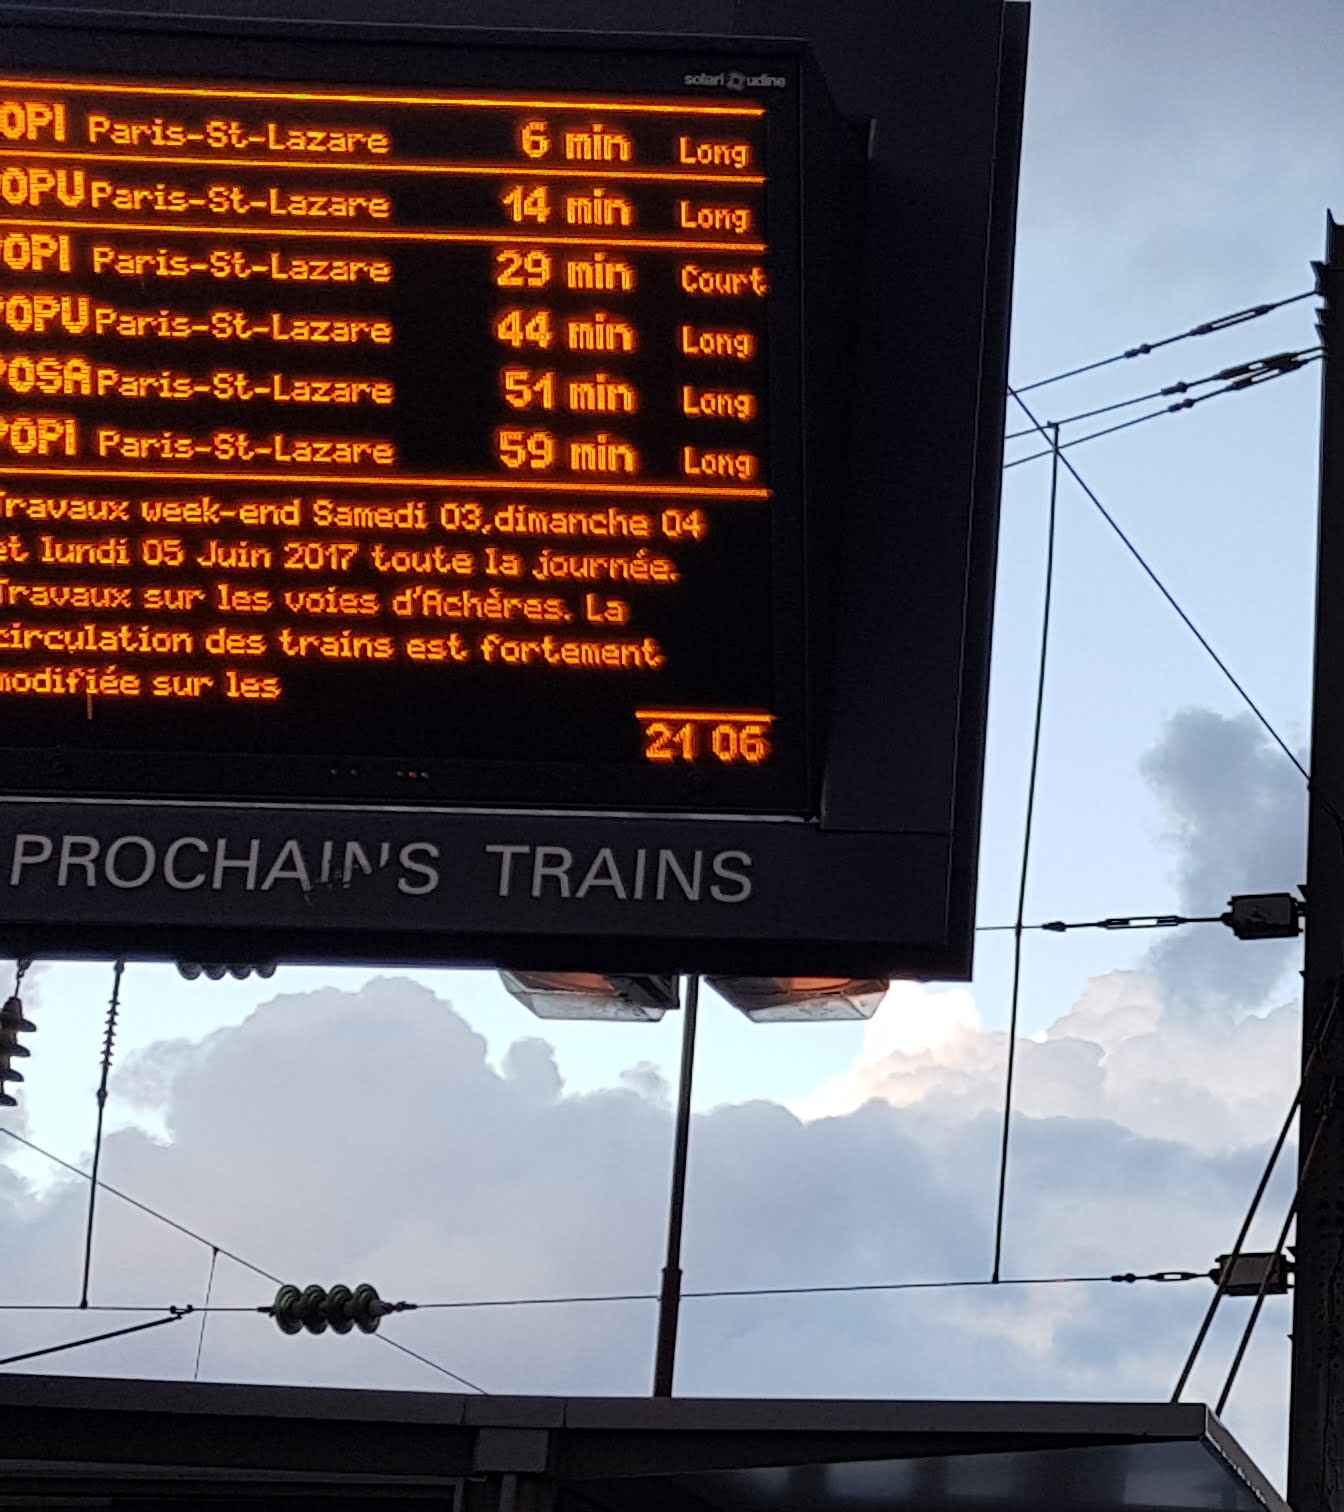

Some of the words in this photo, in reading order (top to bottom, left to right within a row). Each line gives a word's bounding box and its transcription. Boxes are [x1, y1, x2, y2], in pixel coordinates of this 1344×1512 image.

[88, 115, 390, 153] Paris-St-Lazare
[521, 121, 550, 158] 6
[565, 123, 631, 162] min
[679, 137, 748, 169] Long
[90, 181, 390, 218] Paris-St-Lazare
[502, 185, 552, 223] 14
[566, 187, 632, 226] min
[680, 201, 749, 233] Long
[0, 231, 71, 272] OPI
[93, 247, 391, 282] Paris-St-Lazare
[496, 249, 552, 287] 29
[567, 251, 633, 290] min
[681, 265, 767, 295] Court
[0, 293, 90, 334] OPU
[95, 307, 392, 343] Paris-St-Lazare
[497, 309, 553, 348] 44
[567, 313, 634, 351] min
[682, 326, 751, 359] Long
[0, 355, 92, 395] OSA
[97, 369, 393, 404] Paris-St-Lazare
[505, 369, 554, 409] 51
[569, 373, 635, 412] min
[683, 386, 752, 419] Long
[0, 416, 77, 456] OPI
[98, 429, 394, 464] Paris-St-Lazare
[499, 431, 555, 469] 59
[570, 433, 636, 472] min
[684, 447, 753, 480] Long
[141, 496, 301, 526] week-end
[312, 499, 428, 529] Samedi
[661, 509, 703, 538] 04
[41, 535, 130, 565] lundi
[142, 539, 184, 566] 05
[196, 541, 272, 568] Juin
[283, 541, 358, 570] 2017
[371, 545, 473, 574] toute
[485, 547, 520, 576] la
[143, 589, 206, 610] sur
[217, 583, 272, 612] les
[284, 586, 380, 614] voies
[586, 594, 624, 622] La
[205, 627, 267, 655] des
[278, 629, 394, 658] trains
[406, 633, 468, 661] est
[480, 634, 661, 667] fortement
[152, 675, 214, 697] sur
[226, 671, 281, 699] les
[485, 843, 754, 904] TRAINS
